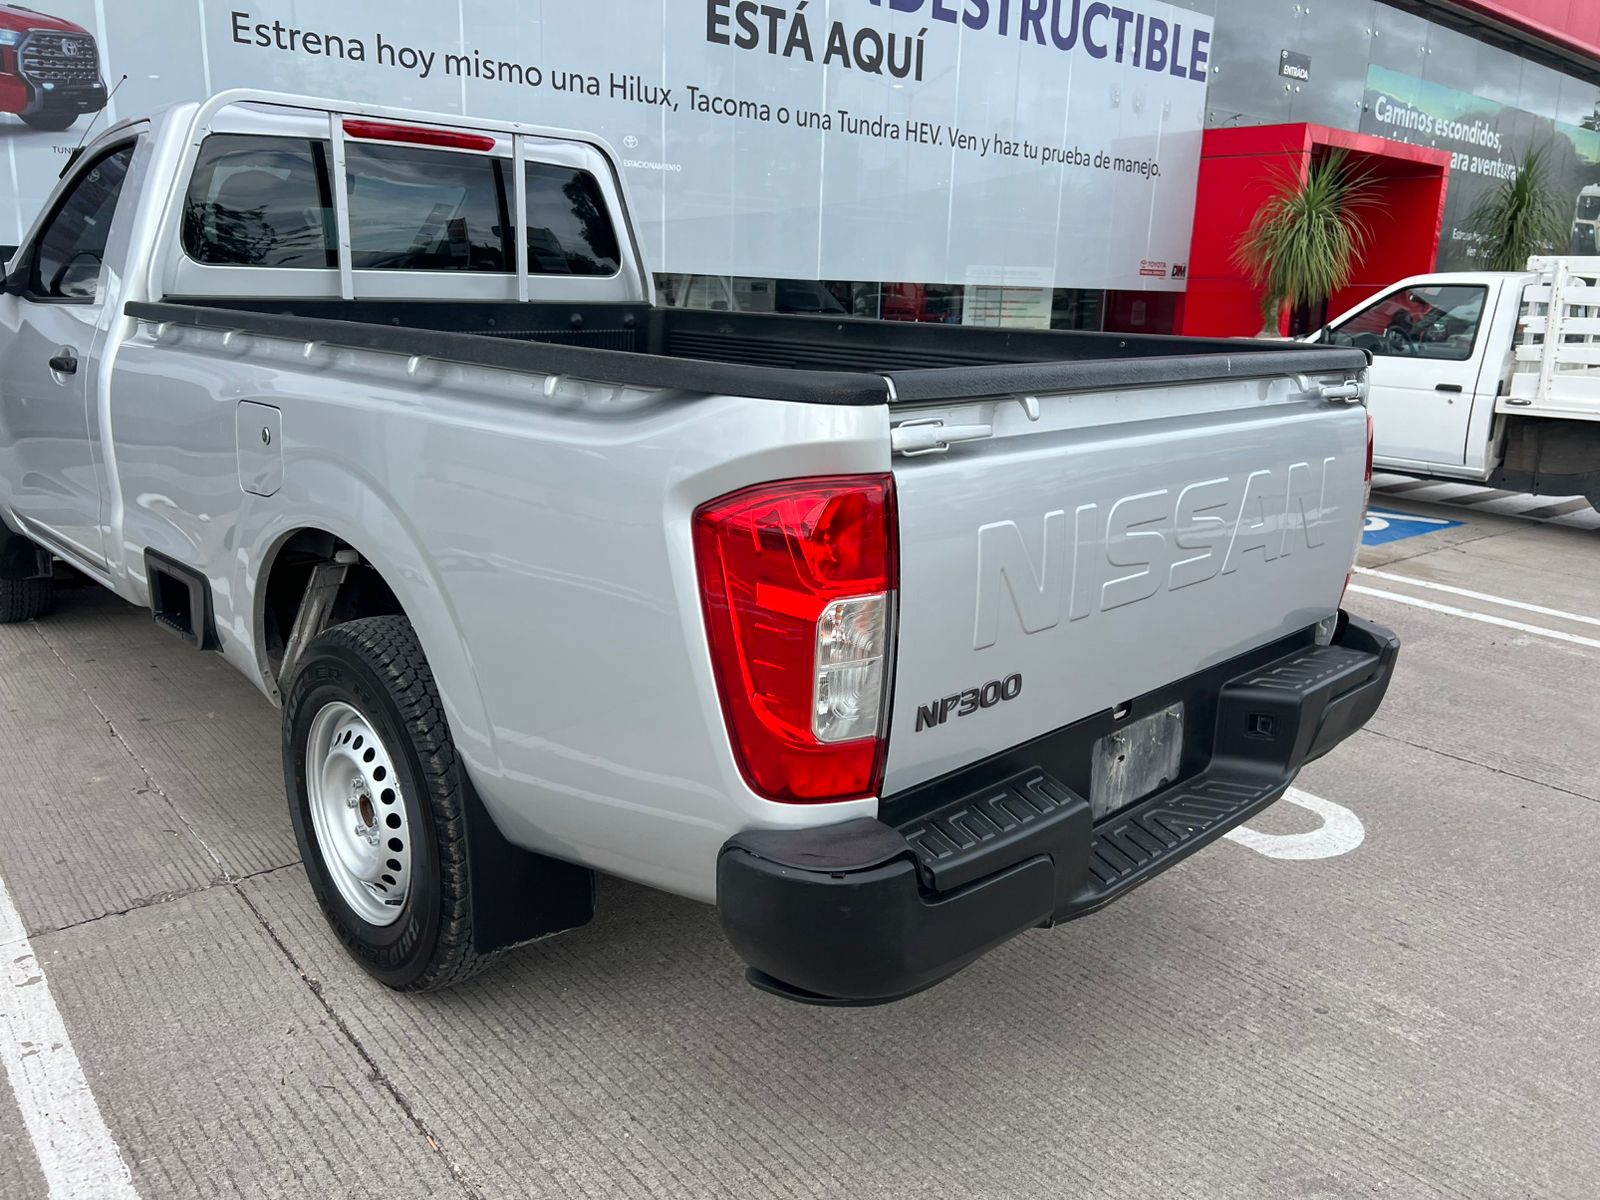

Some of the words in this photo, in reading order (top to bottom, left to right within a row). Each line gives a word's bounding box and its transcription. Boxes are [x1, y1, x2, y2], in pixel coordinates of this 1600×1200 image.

[707, 0, 814, 62] ESTÁ
[823, 21, 928, 82] AQUÍ
[868, 0, 1210, 83] STRUCTIBLE
[231, 11, 365, 61] Estrena
[376, 33, 435, 78] hoy
[445, 49, 542, 87] mismo
[551, 70, 600, 96] una
[609, 72, 679, 112] Hilux,
[686, 85, 770, 121] Tacoma
[776, 107, 790, 124] o
[796, 109, 831, 131] una
[837, 110, 899, 140] Tundra
[905, 120, 943, 146] HEV.
[948, 126, 977, 151] Ven
[980, 136, 990, 157] y
[994, 133, 1019, 157] haz
[1023, 140, 1038, 160] tu
[1041, 146, 1090, 168] prueba
[1094, 150, 1111, 170] de
[1113, 158, 1161, 180] manejo.
[1283, 64, 1308, 80] ENTRADA
[52, 145, 75, 154] TUN
[1374, 95, 1433, 134] Caminos
[1435, 117, 1502, 154] escondidos,
[623, 159, 682, 172] ESTACIONAMIENTO
[1450, 151, 1469, 171] ara
[972, 457, 1336, 651] NISSAN
[914, 673, 1023, 733] NP300
